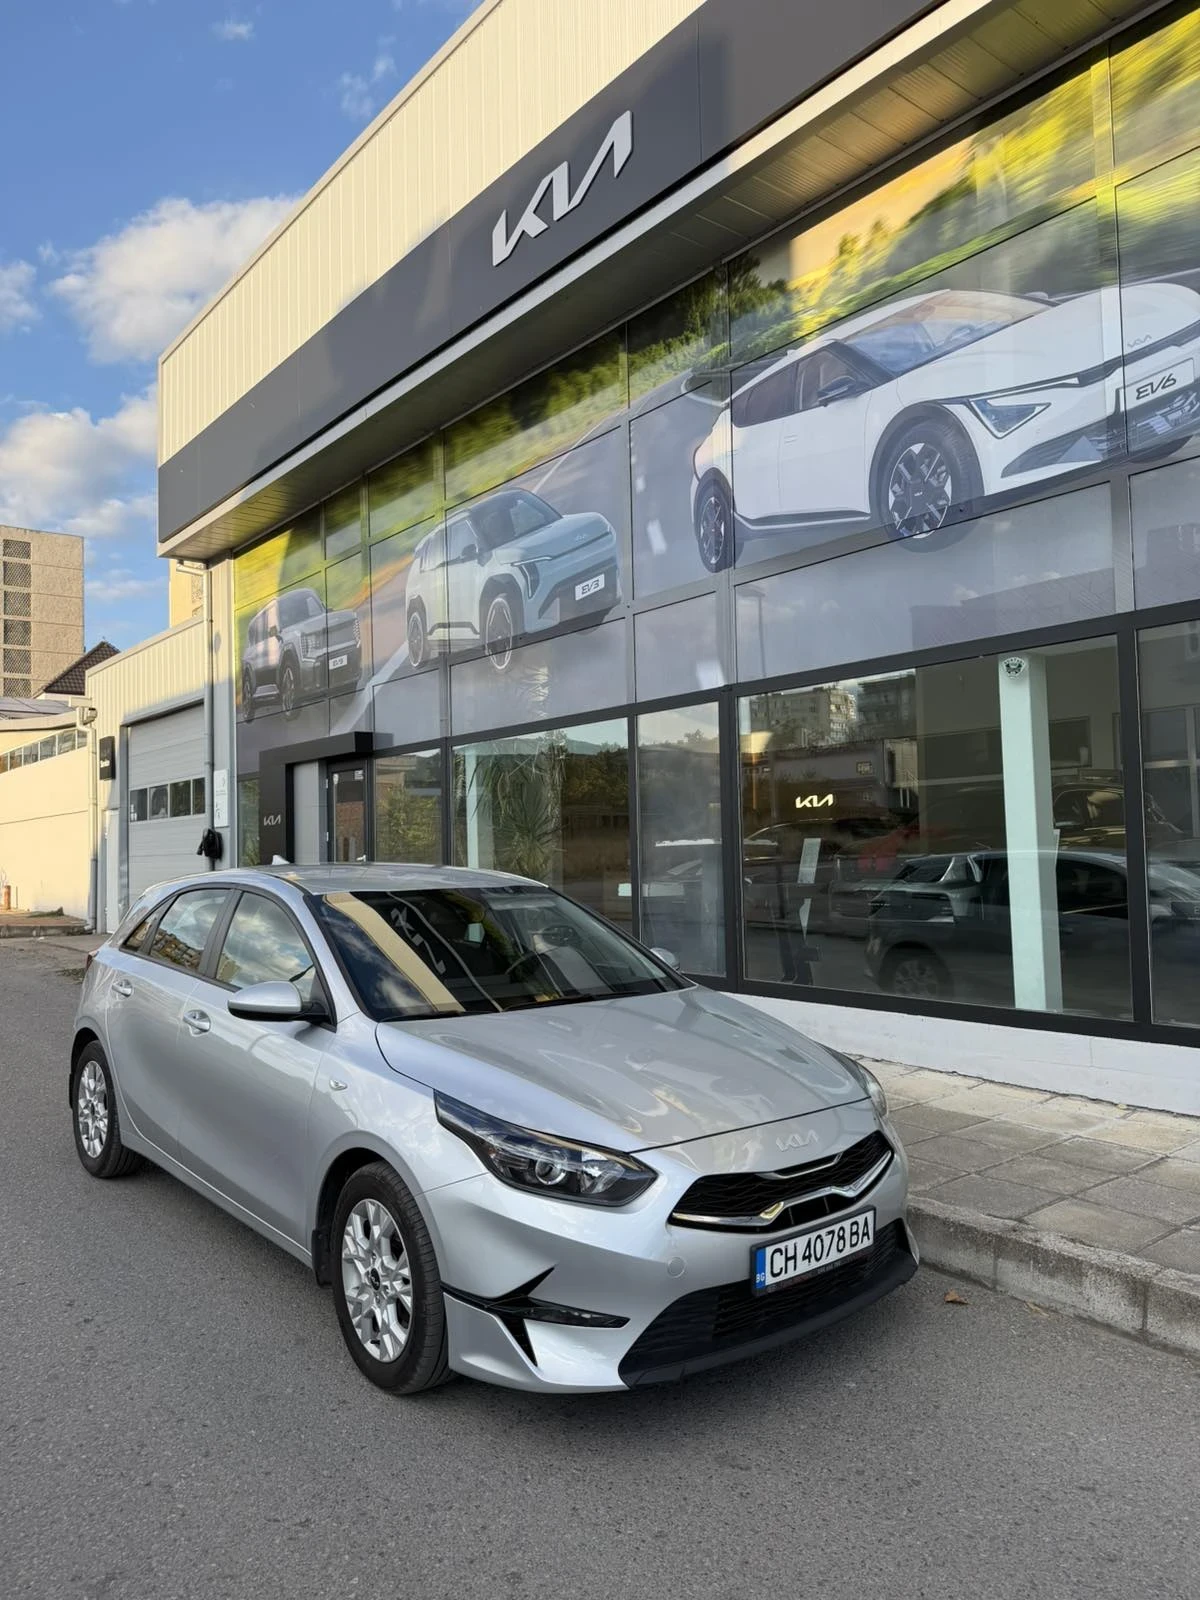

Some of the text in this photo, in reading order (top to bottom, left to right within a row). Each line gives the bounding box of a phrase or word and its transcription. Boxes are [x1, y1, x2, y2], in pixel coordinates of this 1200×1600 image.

[492, 110, 632, 267] KIA
[1135, 373, 1177, 401] EV6
[581, 579, 600, 595] EV3
[795, 793, 834, 809] KIA
[263, 814, 281, 826] KIA
[775, 1129, 819, 1152] KIA
[769, 1216, 871, 1278] CH 4078 BA
[755, 1272, 766, 1283] BG
